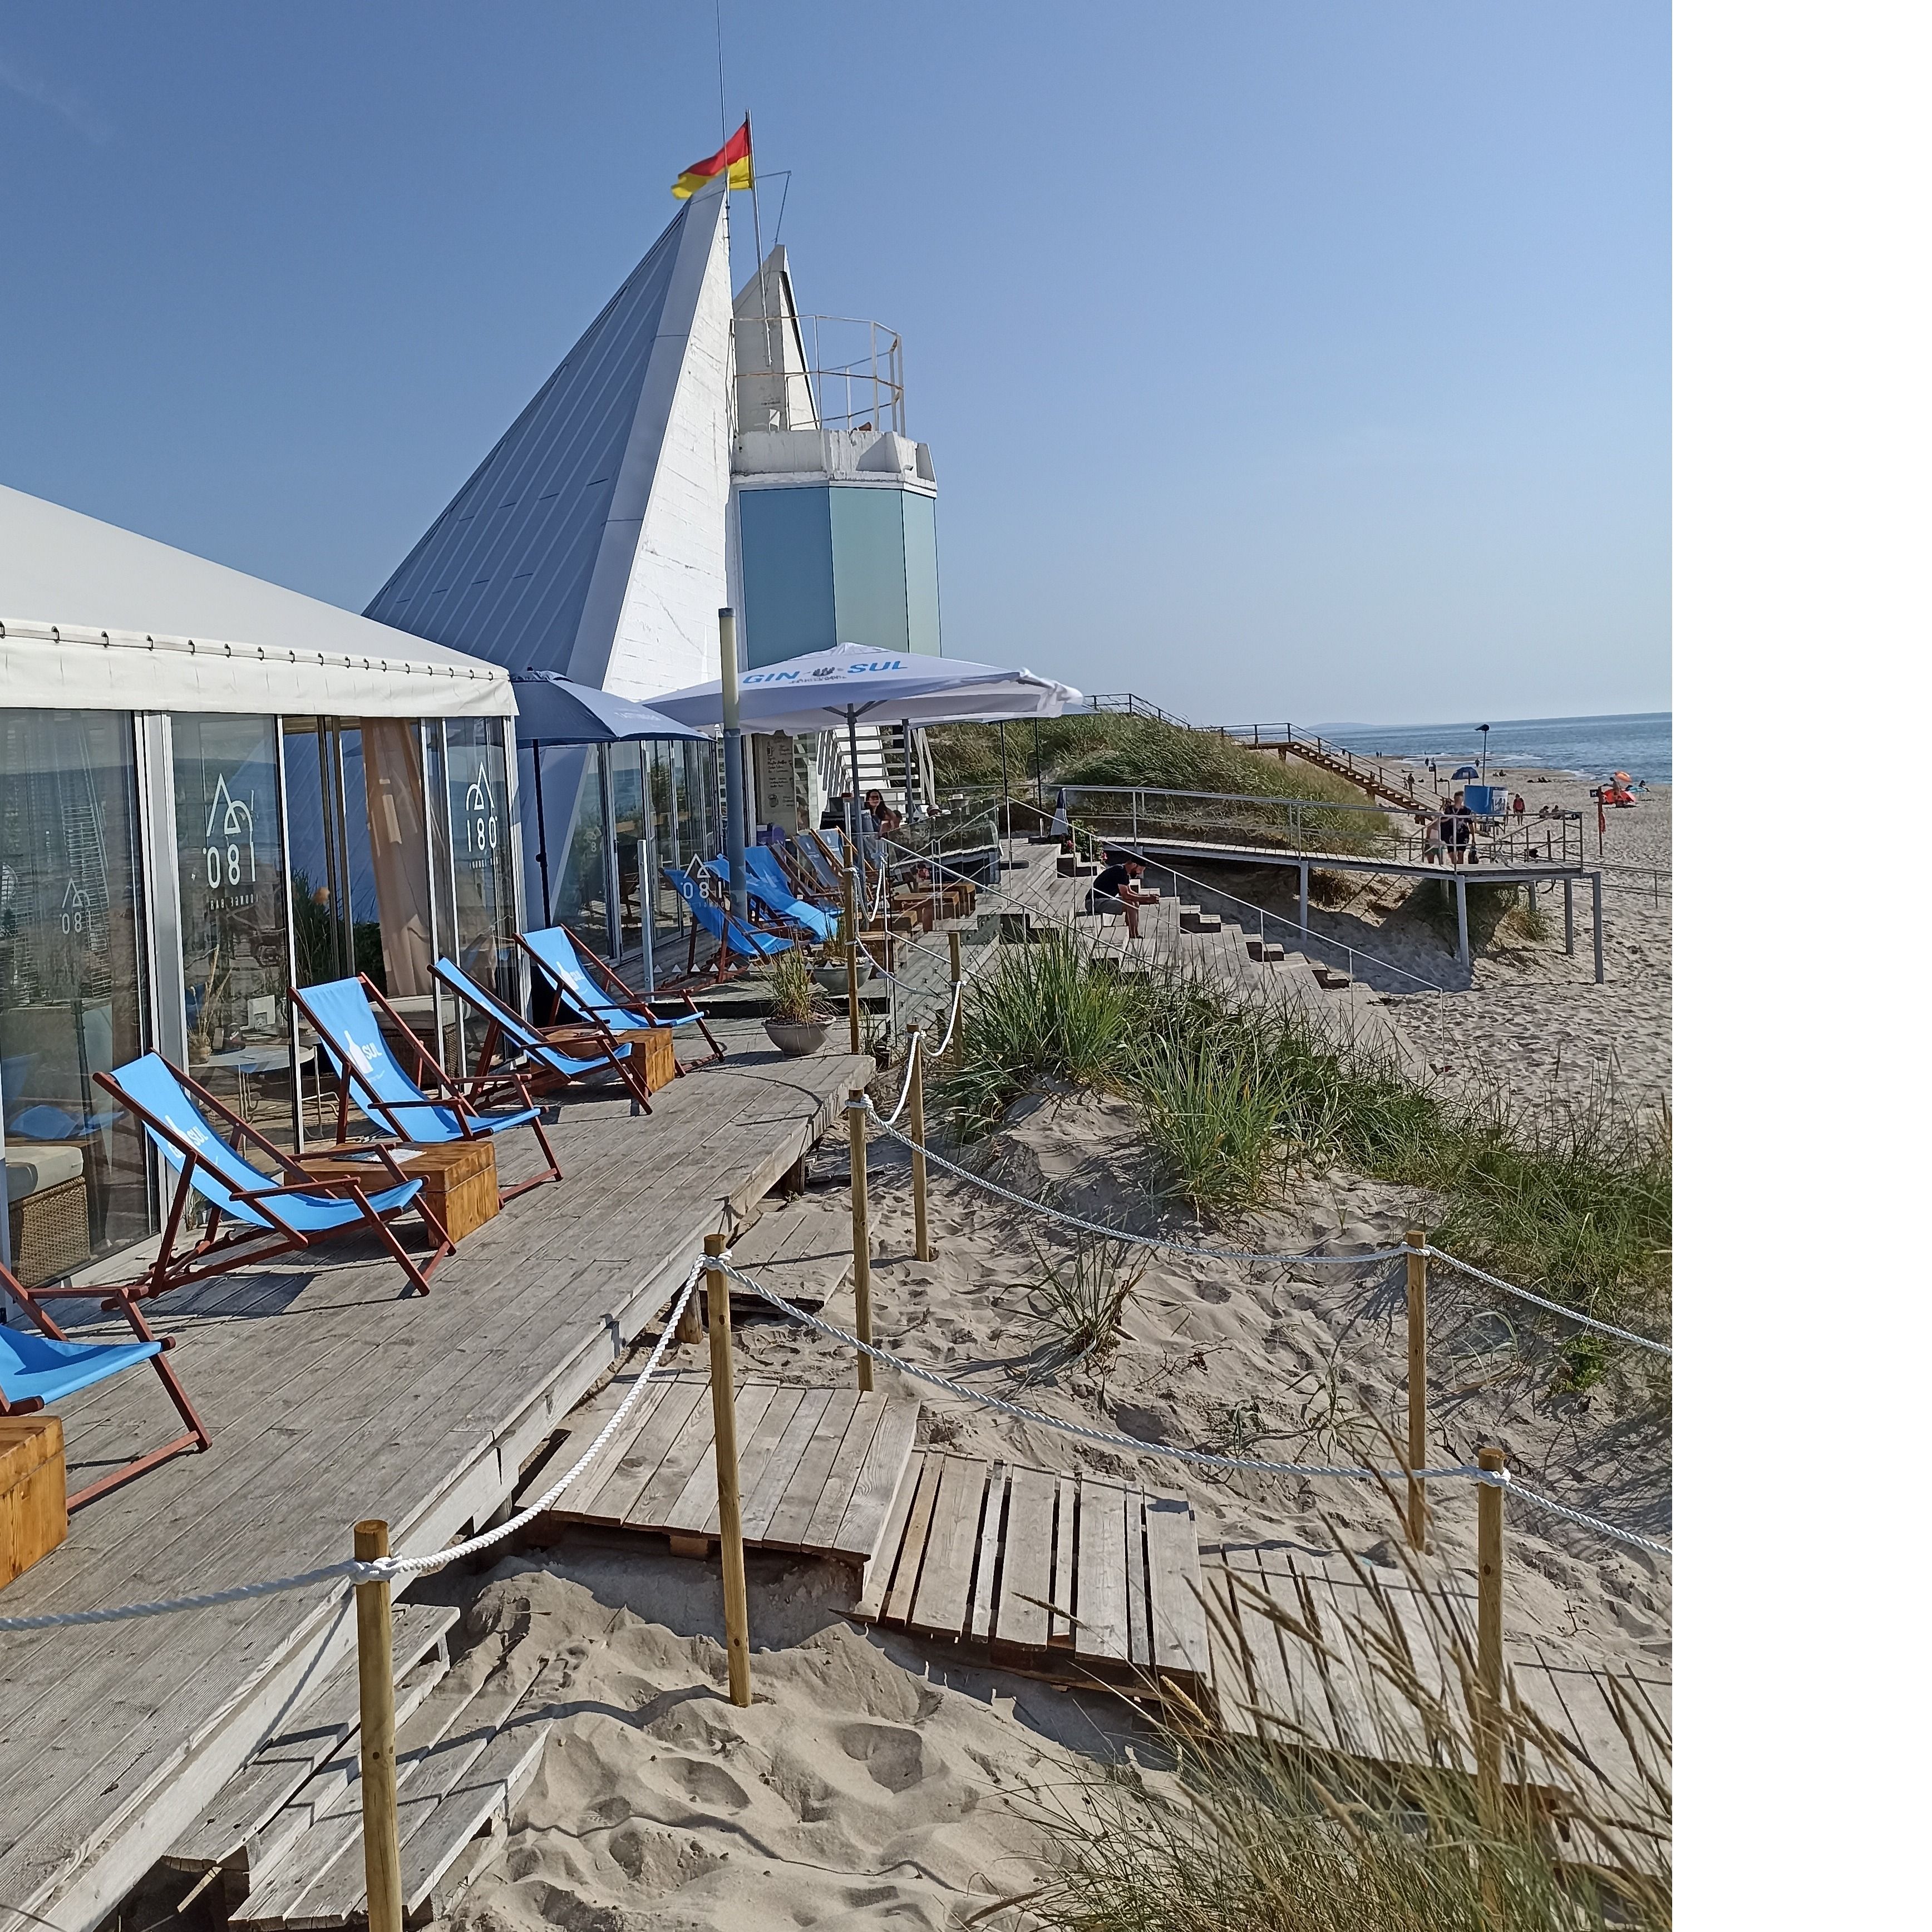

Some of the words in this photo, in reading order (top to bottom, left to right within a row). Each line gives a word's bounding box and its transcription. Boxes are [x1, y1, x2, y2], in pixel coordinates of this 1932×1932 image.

[743, 671, 800, 684] GIN
[847, 661, 908, 673] SUL
[362, 1042, 383, 1060] SUL
[186, 1126, 209, 1146] SUL
